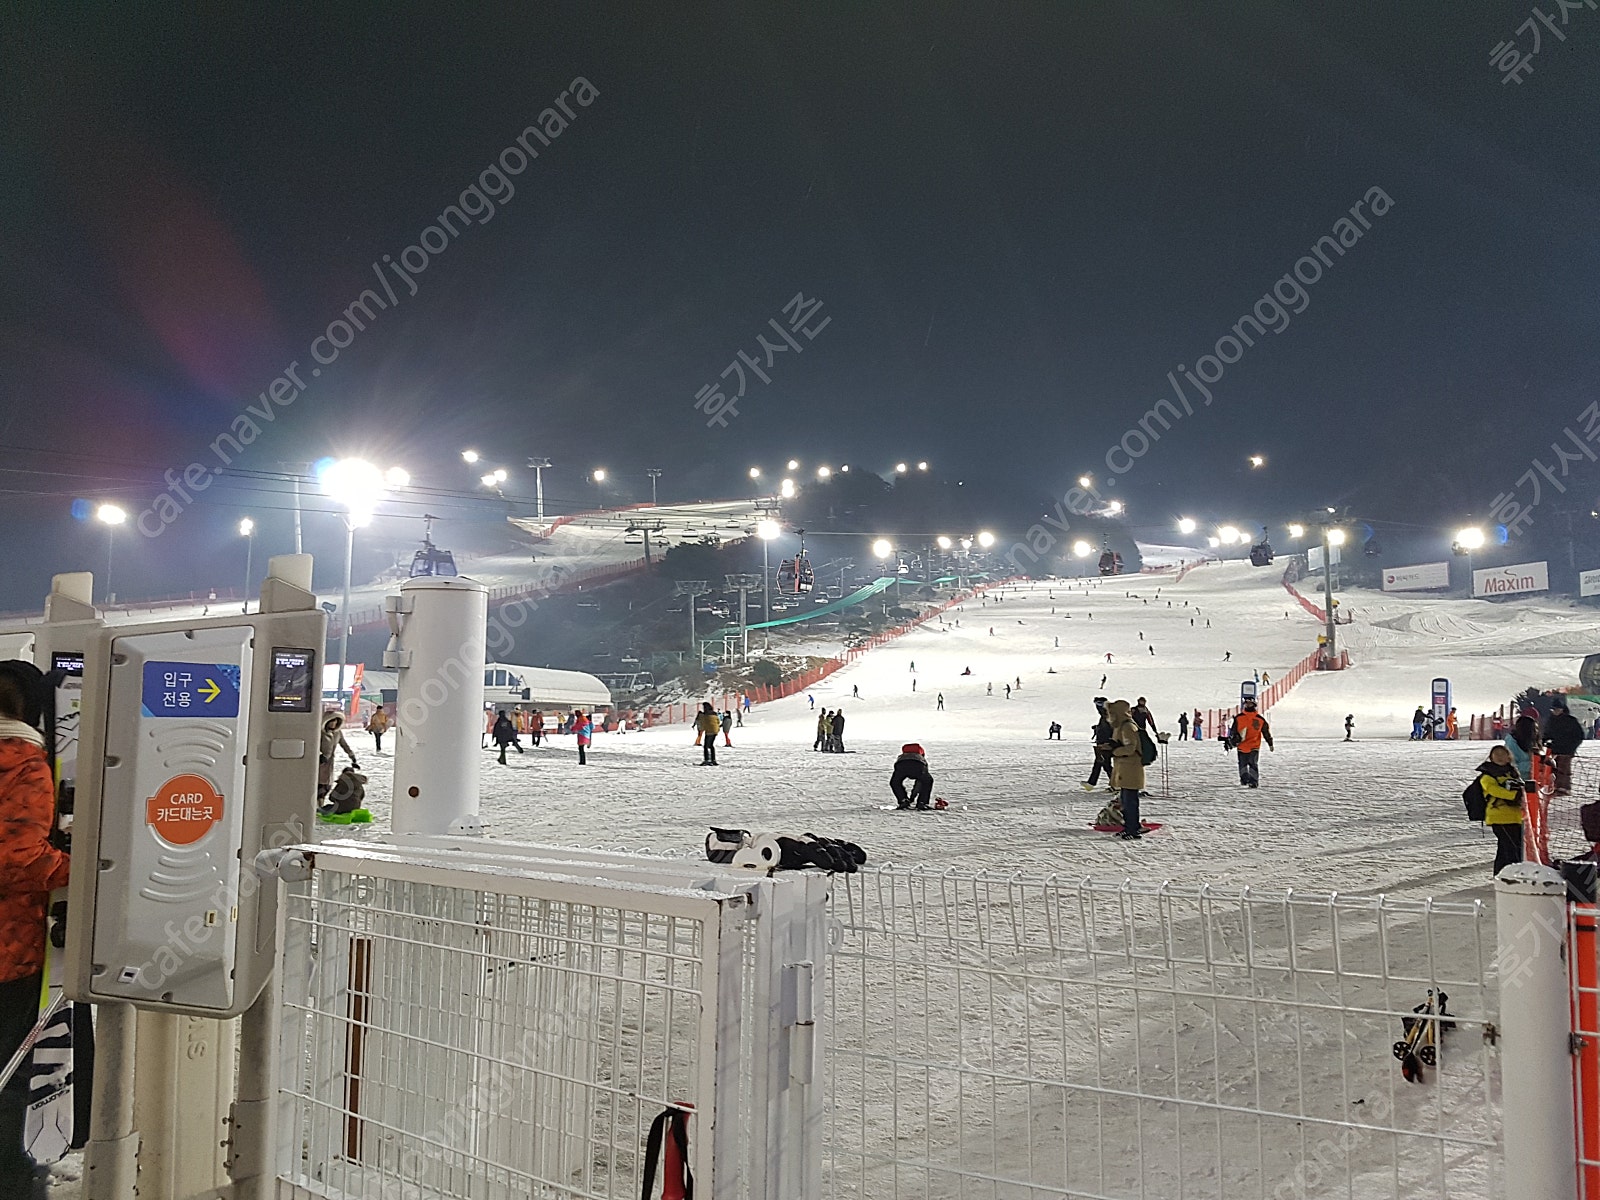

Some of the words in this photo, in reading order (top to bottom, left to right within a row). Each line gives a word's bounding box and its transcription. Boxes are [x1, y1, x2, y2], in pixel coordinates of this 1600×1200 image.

[1484, 575, 1535, 594] Maxim
[163, 671, 193, 688] 입구
[162, 691, 192, 708] 전용
[170, 792, 203, 805] CARD
[156, 805, 214, 822] 카드대는곳
